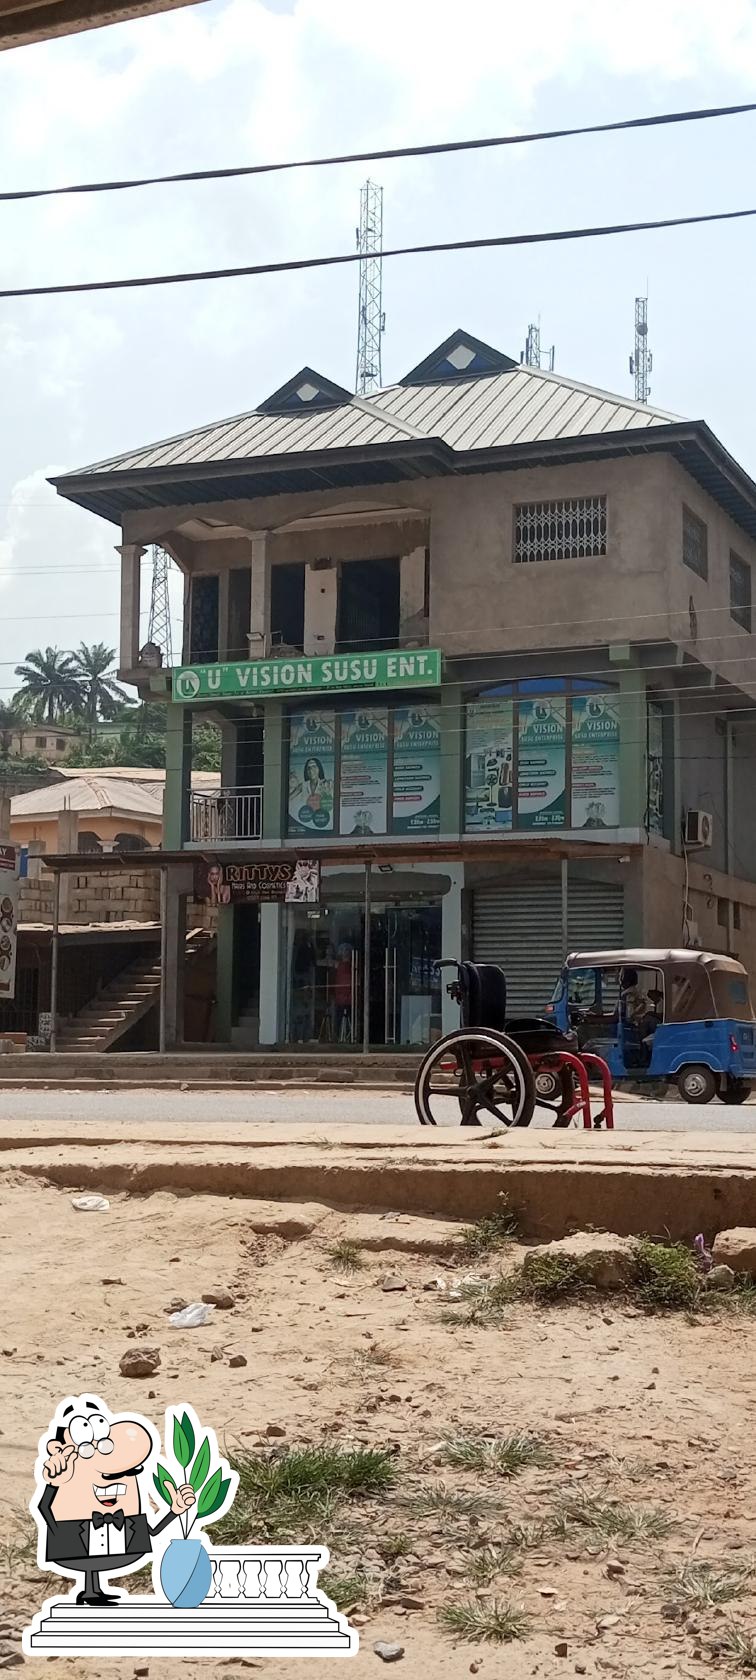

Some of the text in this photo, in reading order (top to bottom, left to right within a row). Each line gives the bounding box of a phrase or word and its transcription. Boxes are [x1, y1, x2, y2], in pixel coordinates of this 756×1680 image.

[236, 663, 312, 688] VISION
[321, 658, 377, 683] SUSU
[387, 655, 433, 678] ENT.
[533, 723, 563, 734] VISION
[587, 720, 617, 730] VISION
[355, 733, 385, 742] VISION
[409, 730, 438, 739] VISION
[304, 735, 332, 745] VISION
[226, 864, 291, 881] RITTYS
